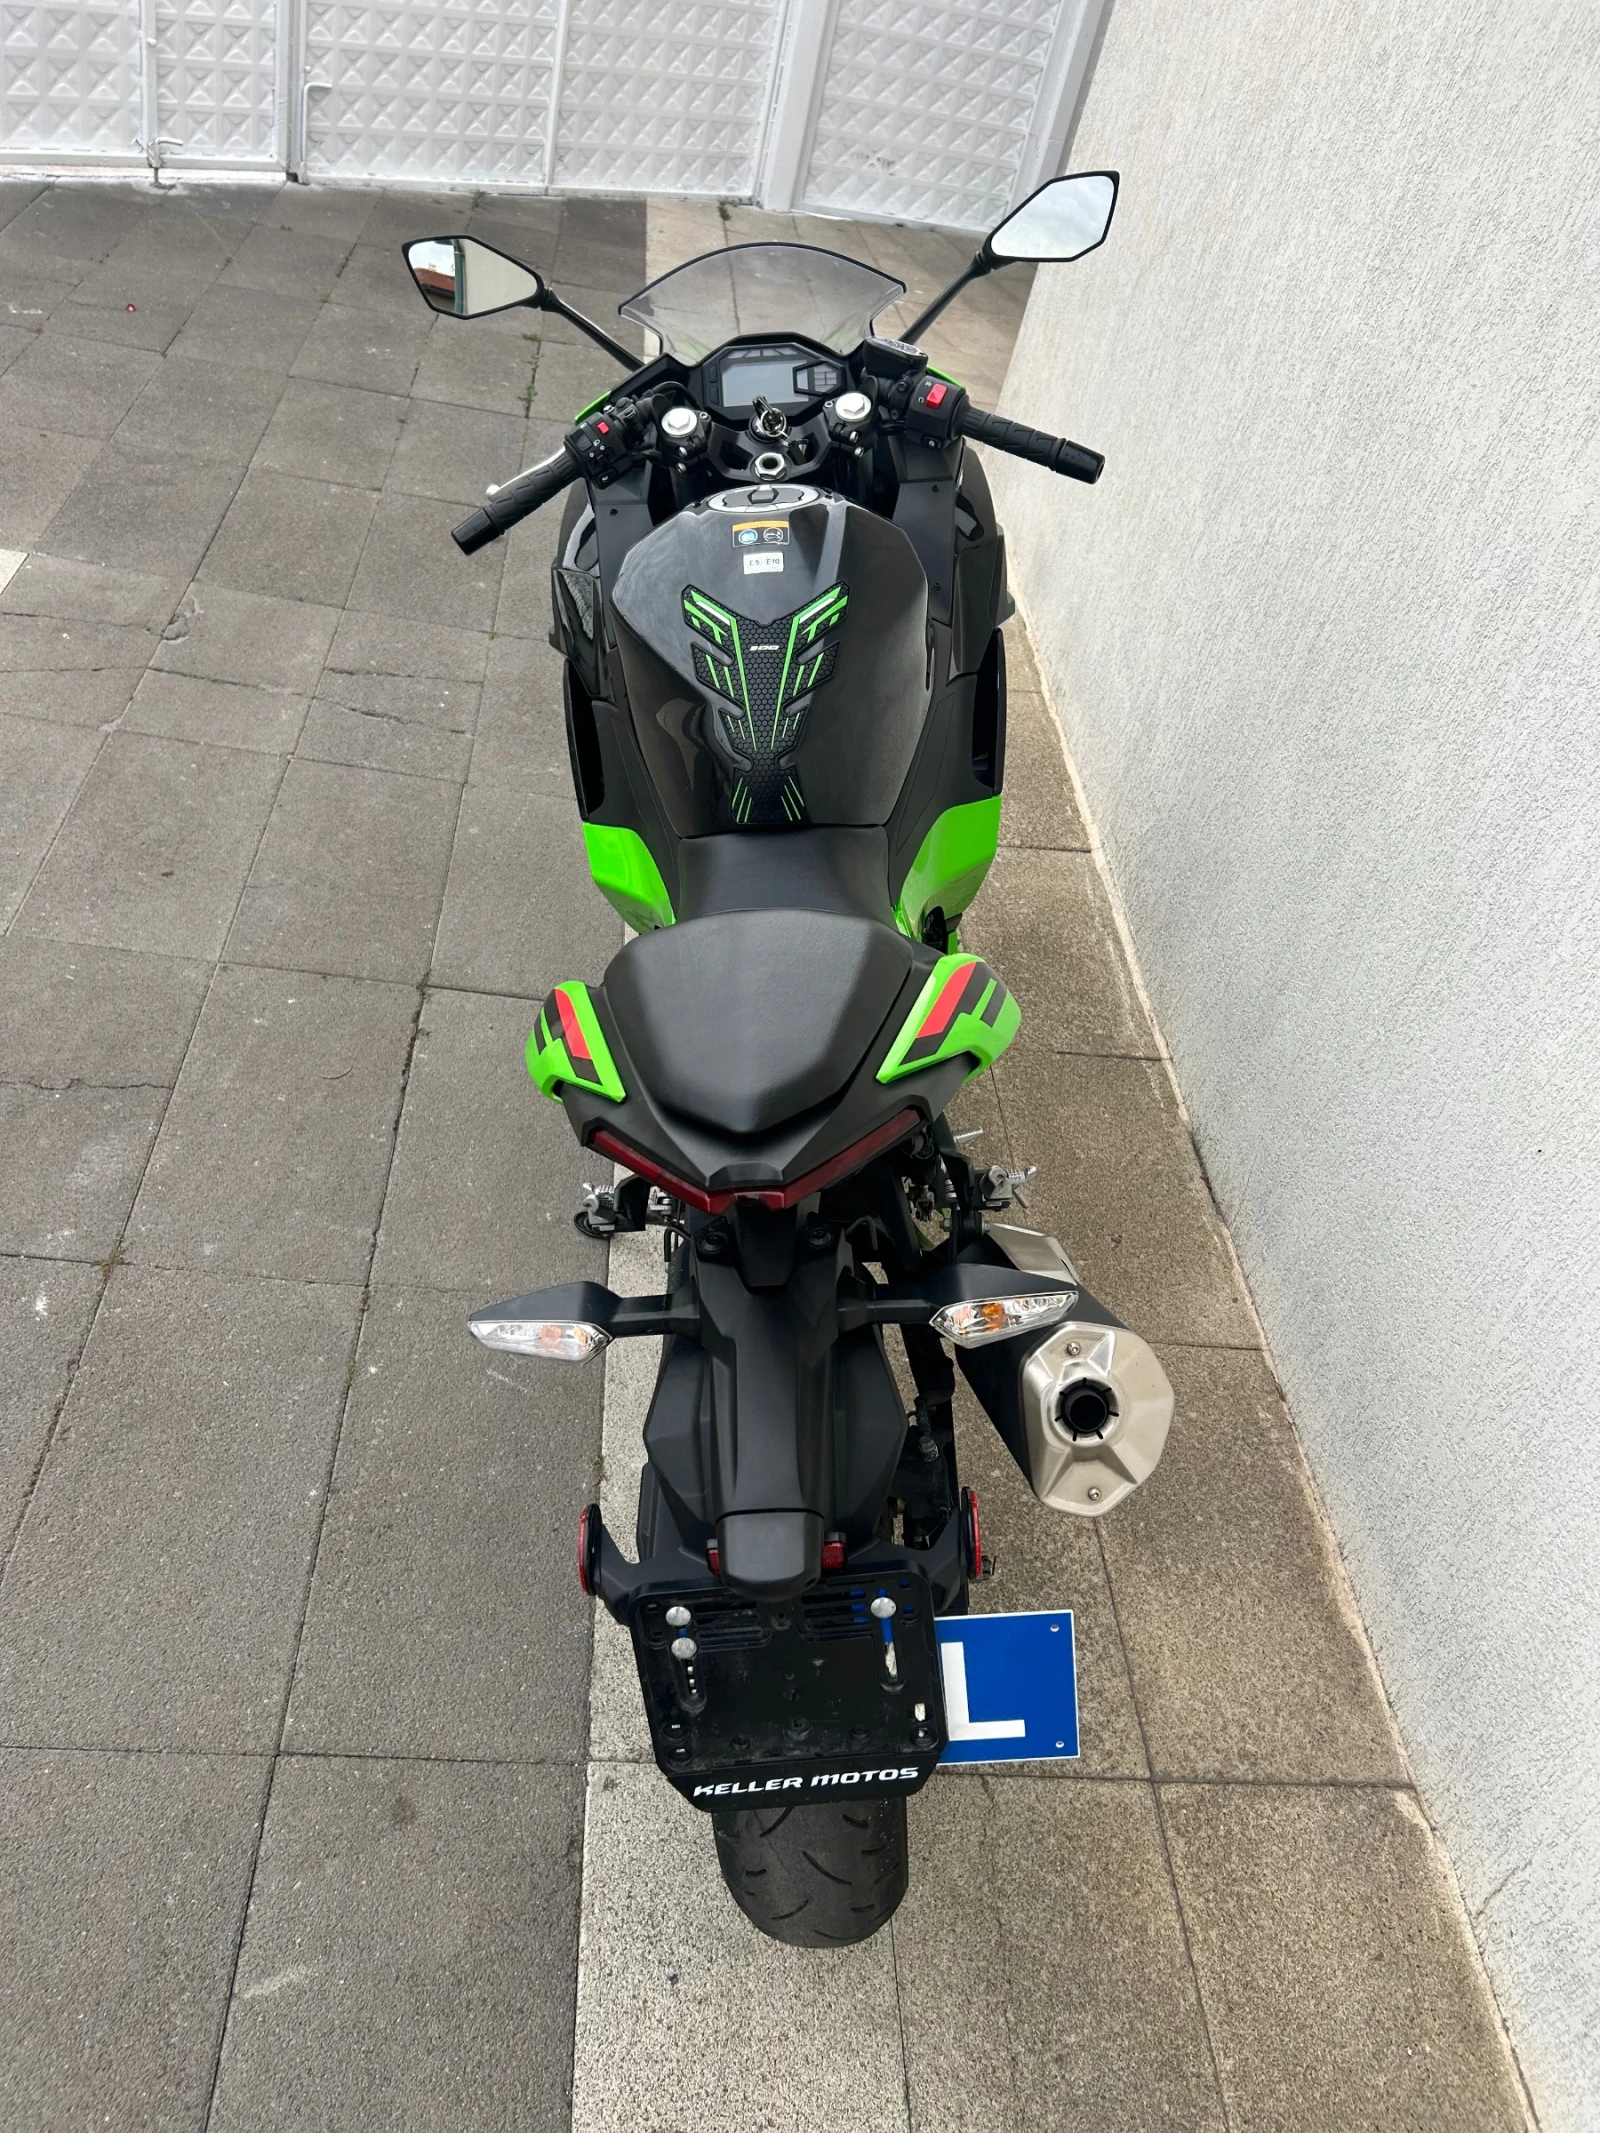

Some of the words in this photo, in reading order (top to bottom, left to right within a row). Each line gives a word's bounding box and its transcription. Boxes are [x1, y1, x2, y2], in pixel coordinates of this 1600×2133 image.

[940, 1641, 1026, 1742] L
[692, 1776, 804, 1797] KELLER
[810, 1766, 919, 1787] MOTOS
